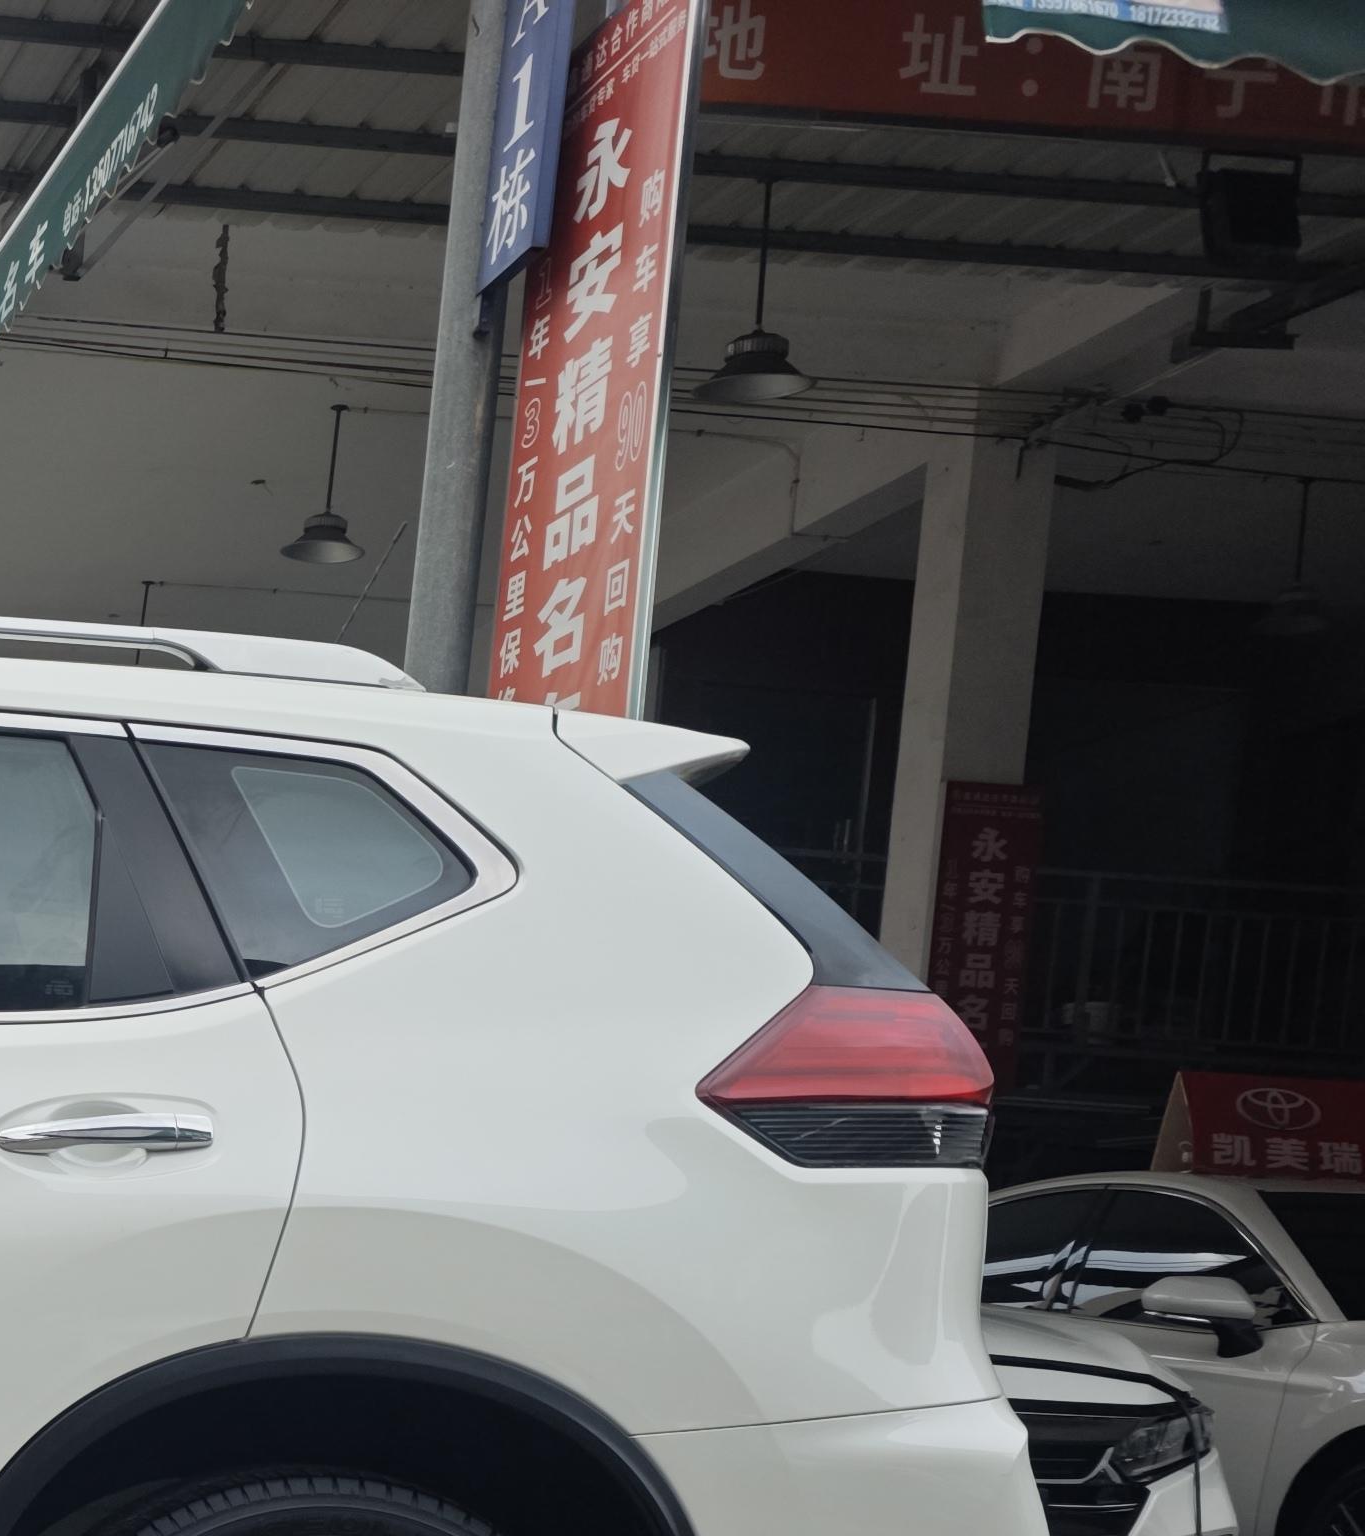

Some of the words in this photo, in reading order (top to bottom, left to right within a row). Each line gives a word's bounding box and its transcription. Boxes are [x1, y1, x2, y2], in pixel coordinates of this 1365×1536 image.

[533, 117, 632, 710] 永安精品名
[957, 827, 1008, 1048] 永安精品名
[1212, 1132, 1363, 1175] 凯美瑞
